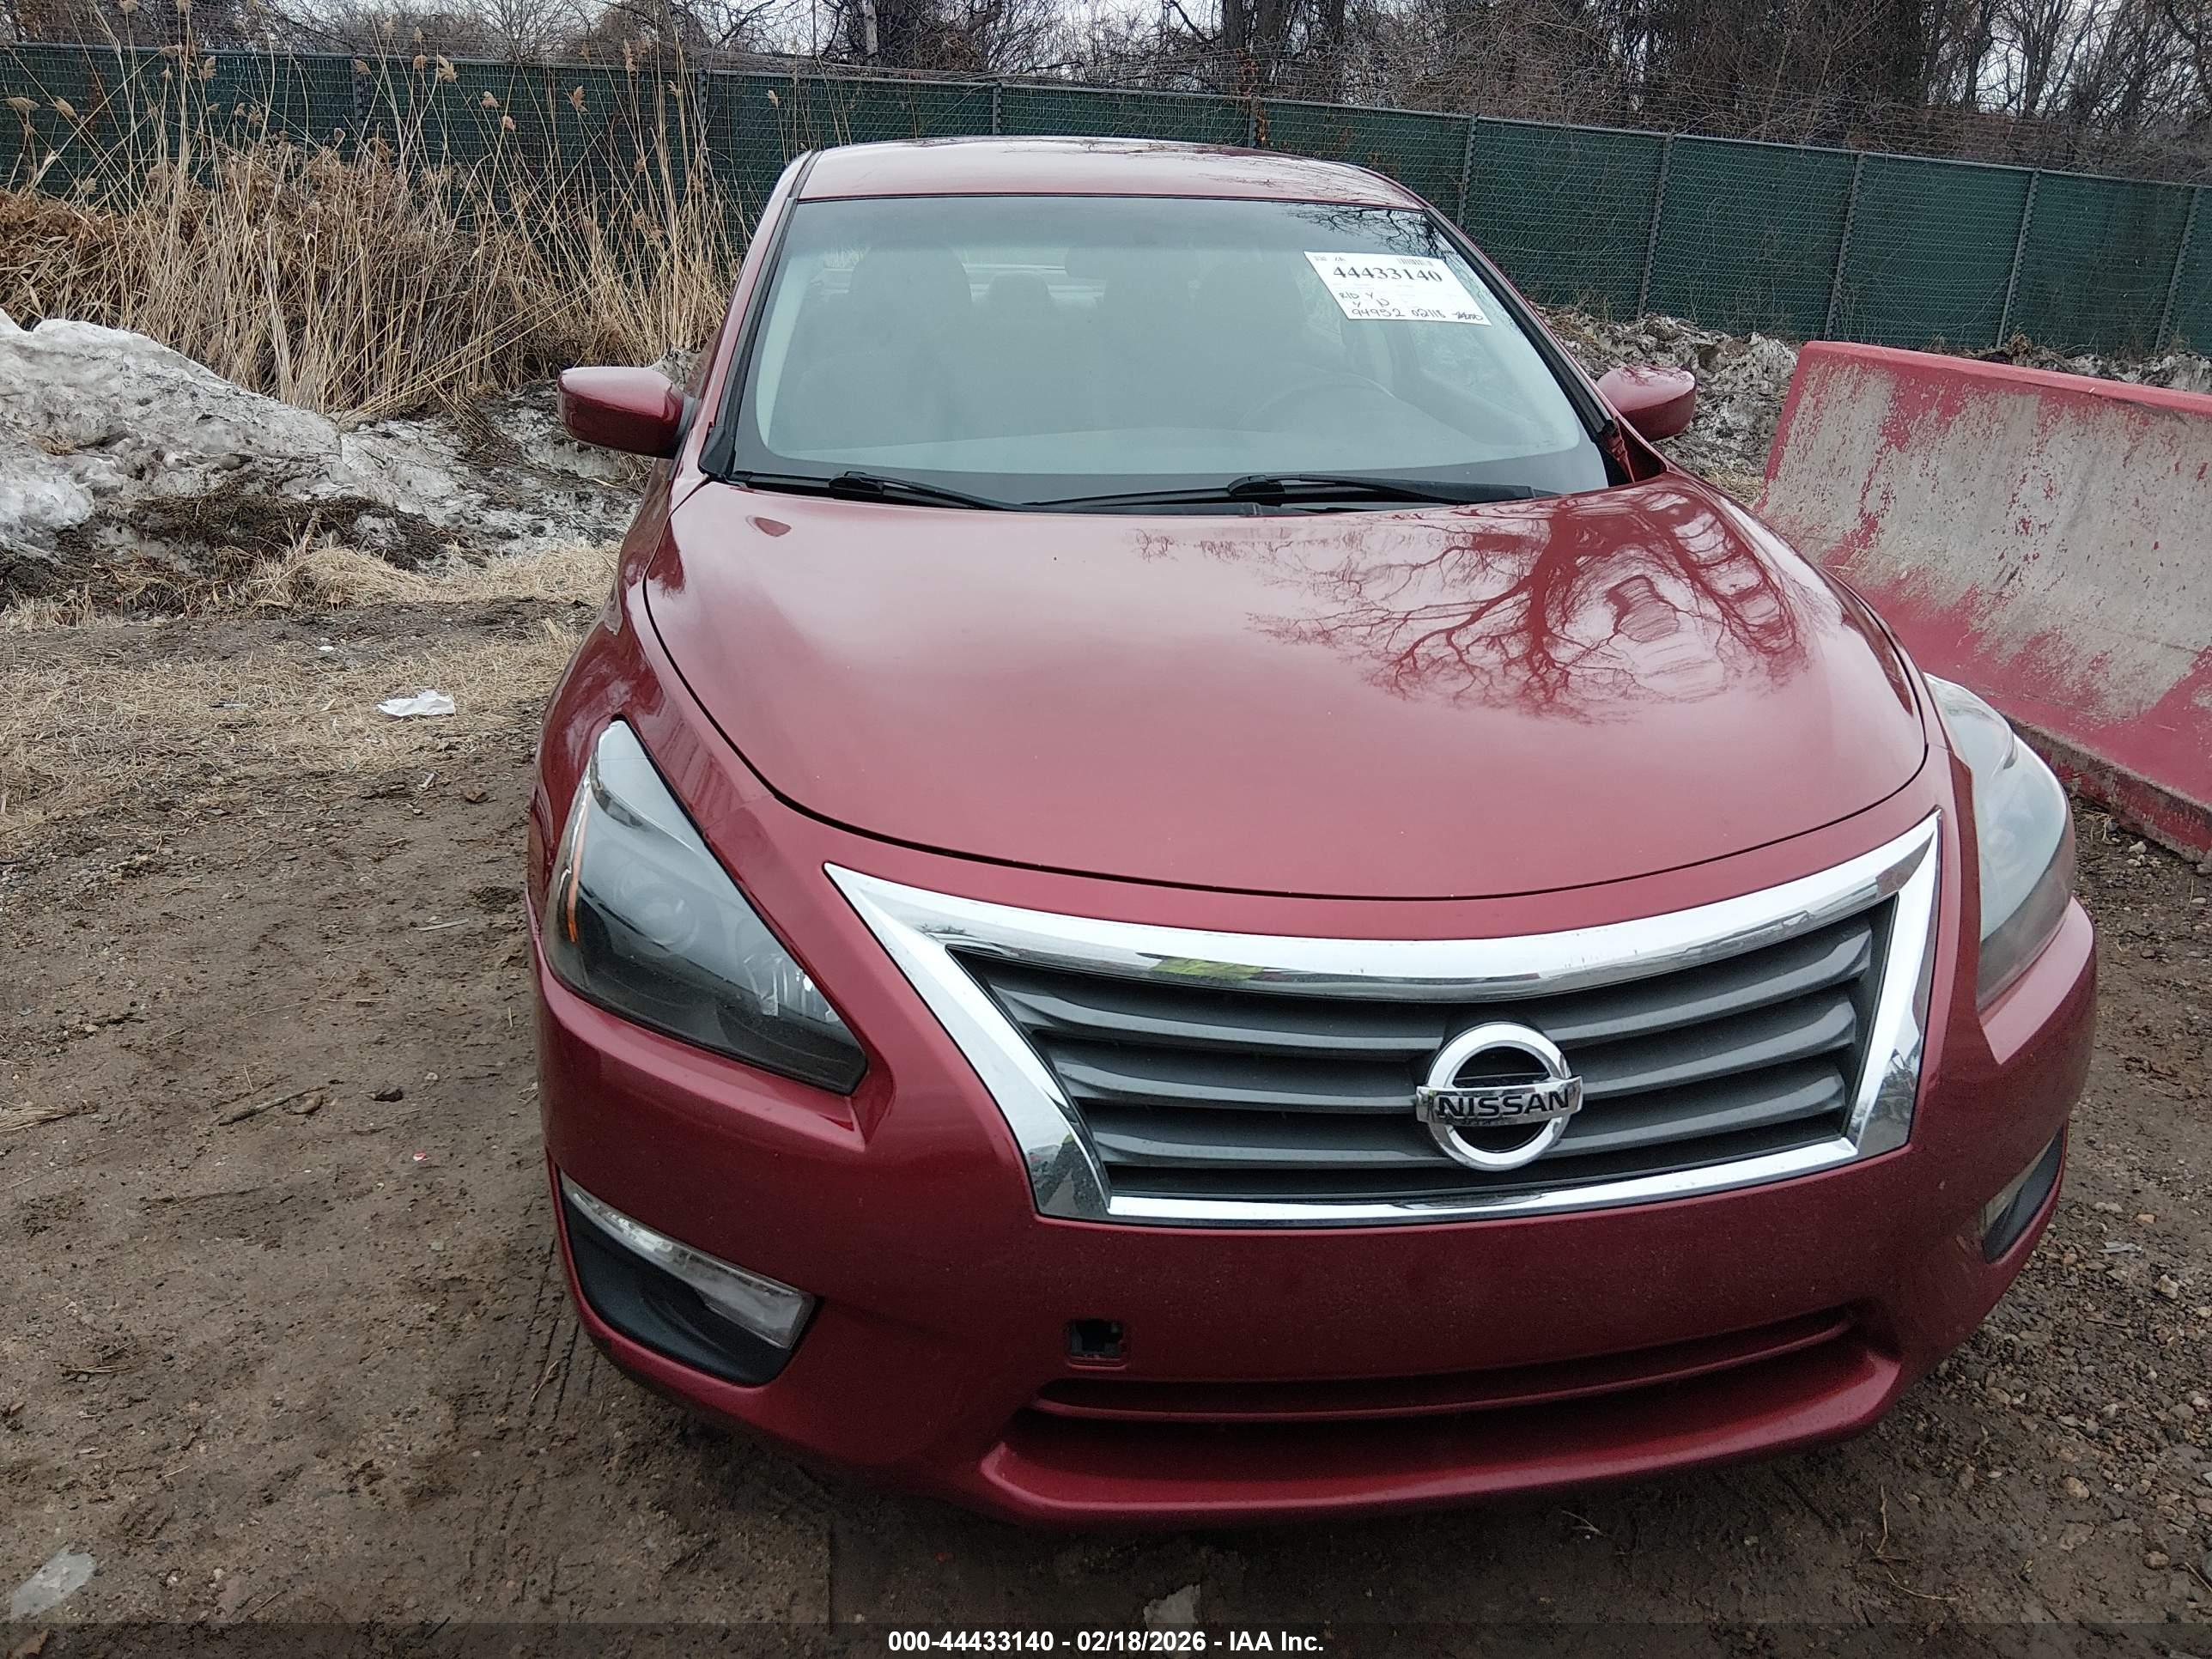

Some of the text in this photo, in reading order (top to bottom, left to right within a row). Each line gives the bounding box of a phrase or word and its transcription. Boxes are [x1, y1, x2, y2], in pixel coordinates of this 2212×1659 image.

[1333, 266, 1443, 283] 44433140
[1352, 308, 1406, 318] 94952
[1438, 1089, 1569, 1117] NISSAN
